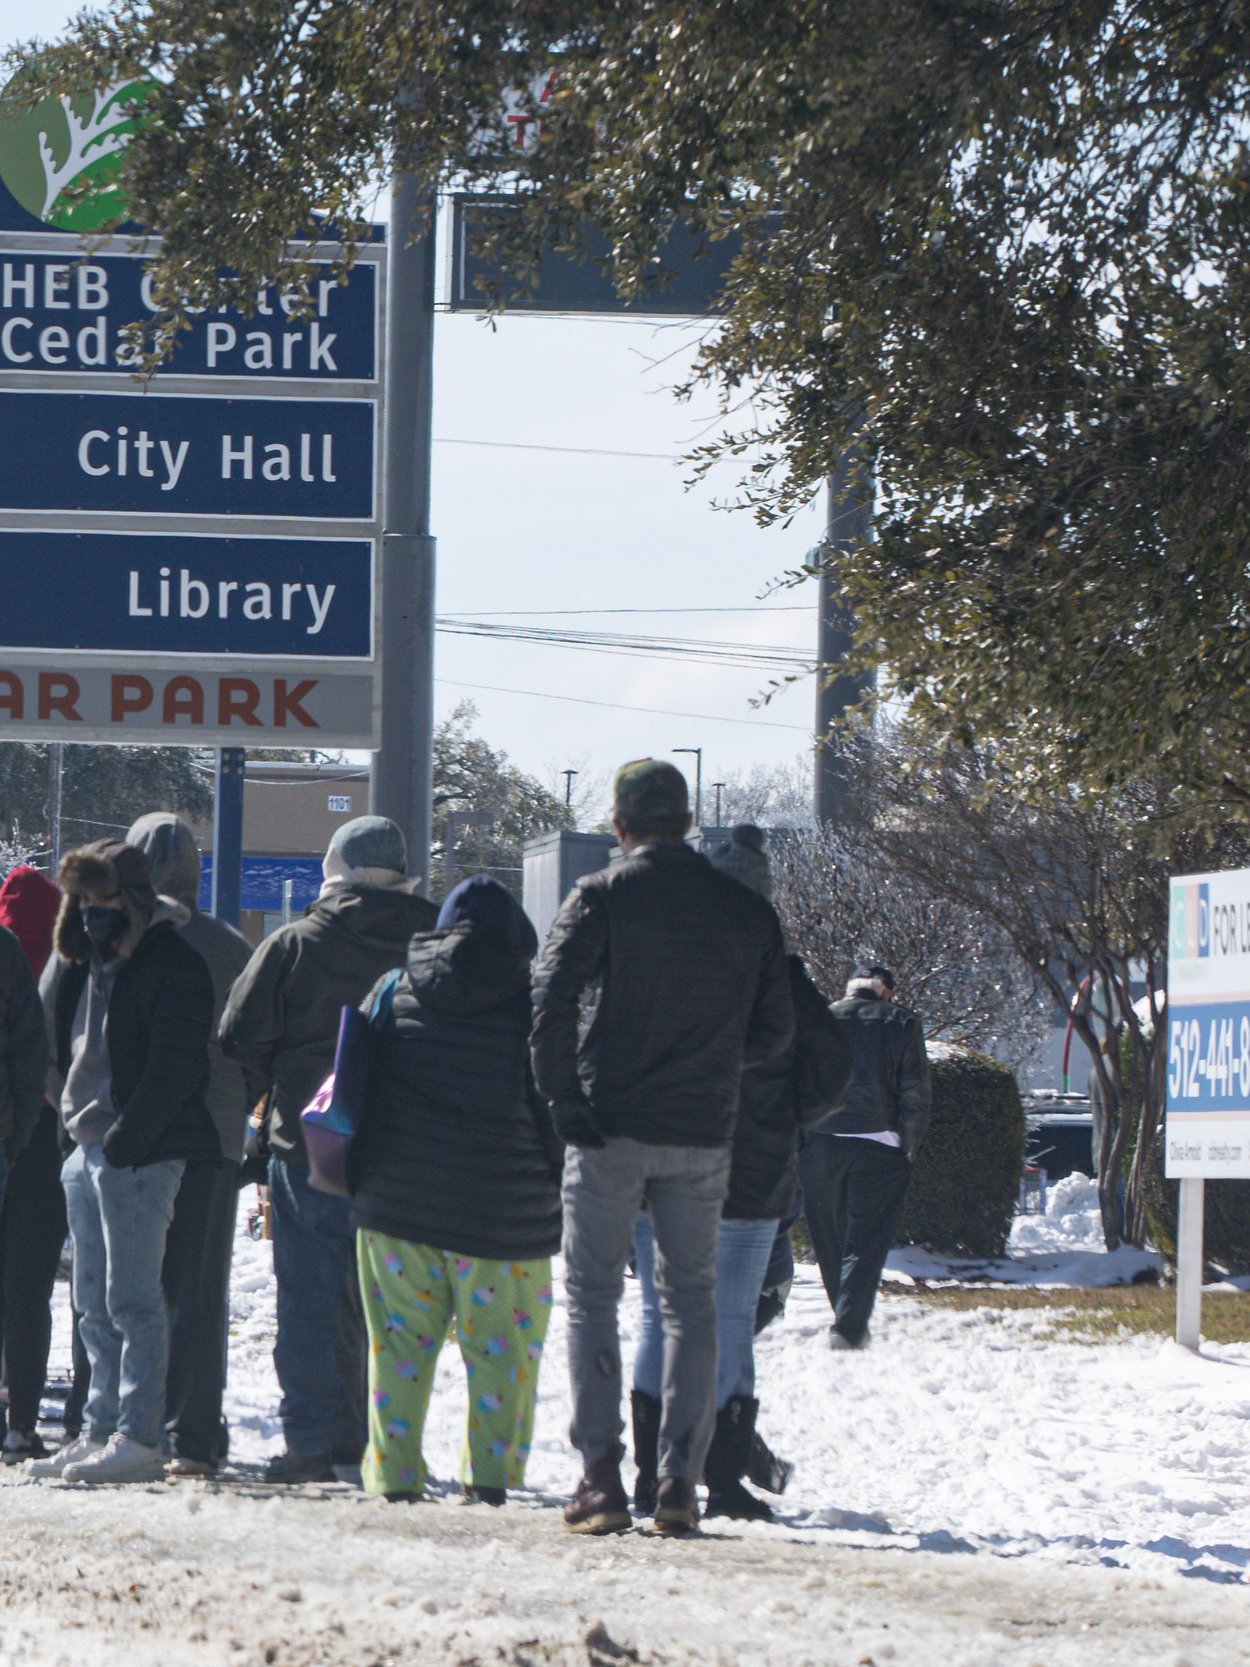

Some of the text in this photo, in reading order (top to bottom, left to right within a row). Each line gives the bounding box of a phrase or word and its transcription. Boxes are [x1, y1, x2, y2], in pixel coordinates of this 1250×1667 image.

[2, 263, 110, 310] HEB
[207, 322, 339, 371] Park
[78, 426, 337, 491] City Hall
[128, 567, 337, 635] Library
[110, 673, 321, 728] PARK
[1214, 903, 1238, 956] FOR
[1168, 1015, 1250, 1099] 512-441-8
